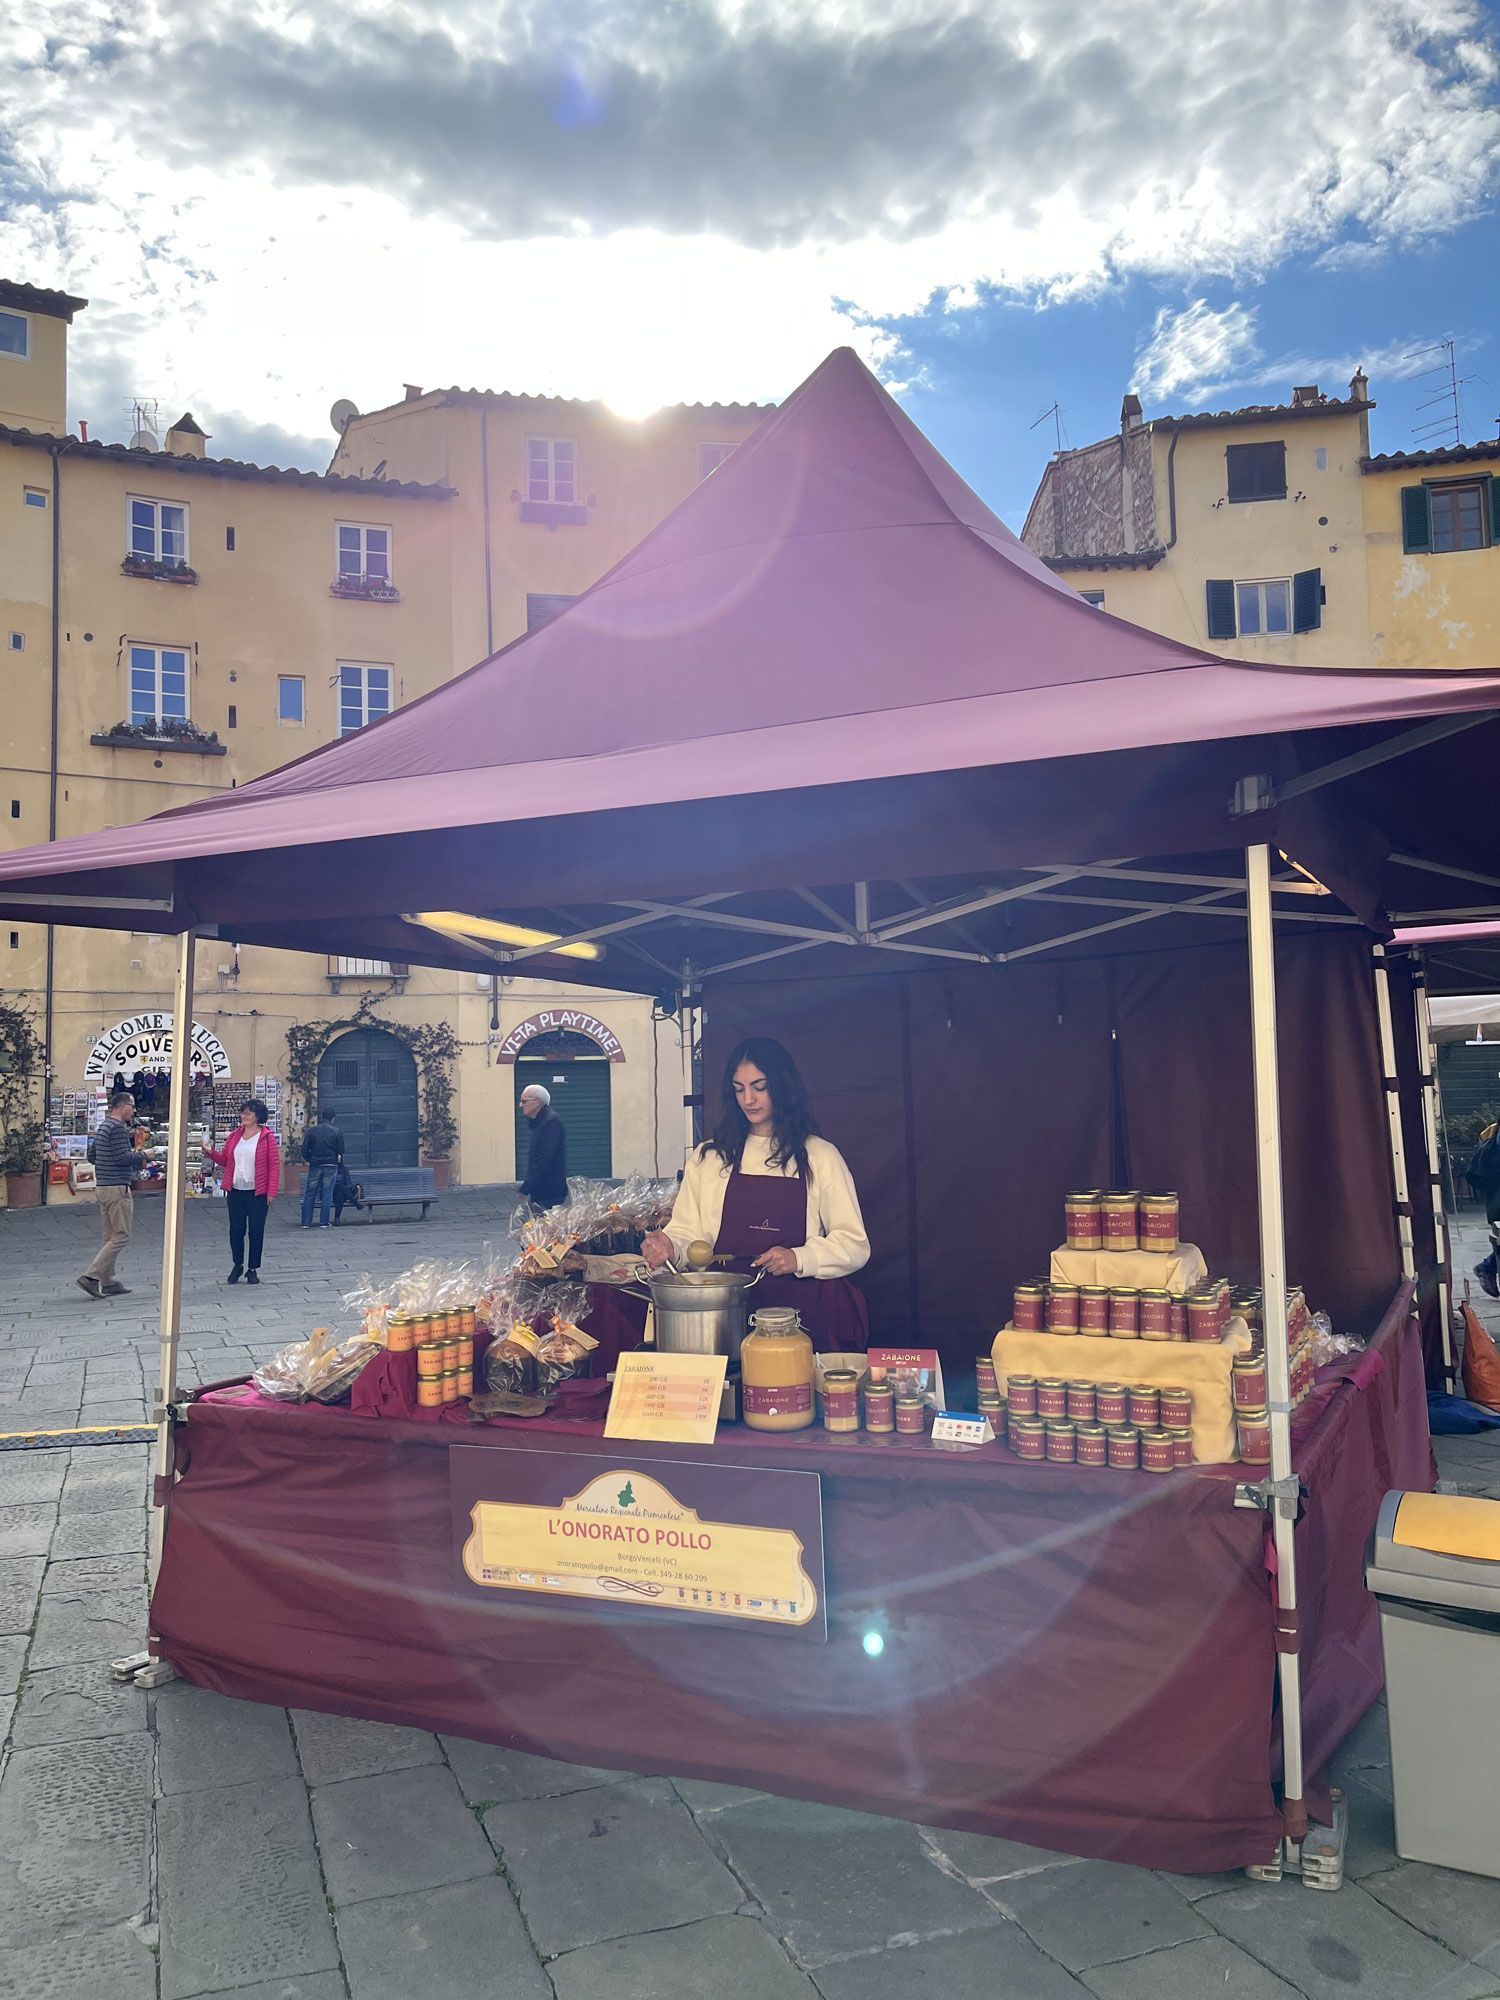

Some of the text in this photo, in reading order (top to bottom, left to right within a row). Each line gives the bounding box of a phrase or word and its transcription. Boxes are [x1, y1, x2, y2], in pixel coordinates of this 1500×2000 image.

[86, 1014, 228, 1075] WELCOME LUCCA
[501, 1012, 621, 1056] VI-TA PLAYTIME!
[115, 1038, 202, 1066] SOUVER
[881, 1353, 921, 1361] ZABAIONE
[548, 1519, 712, 1550] L'ONORATO POLLO
[556, 1560, 638, 1575] onoratopollo@gmail.com
[617, 1552, 678, 1567] BorgoVercelli (VC)
